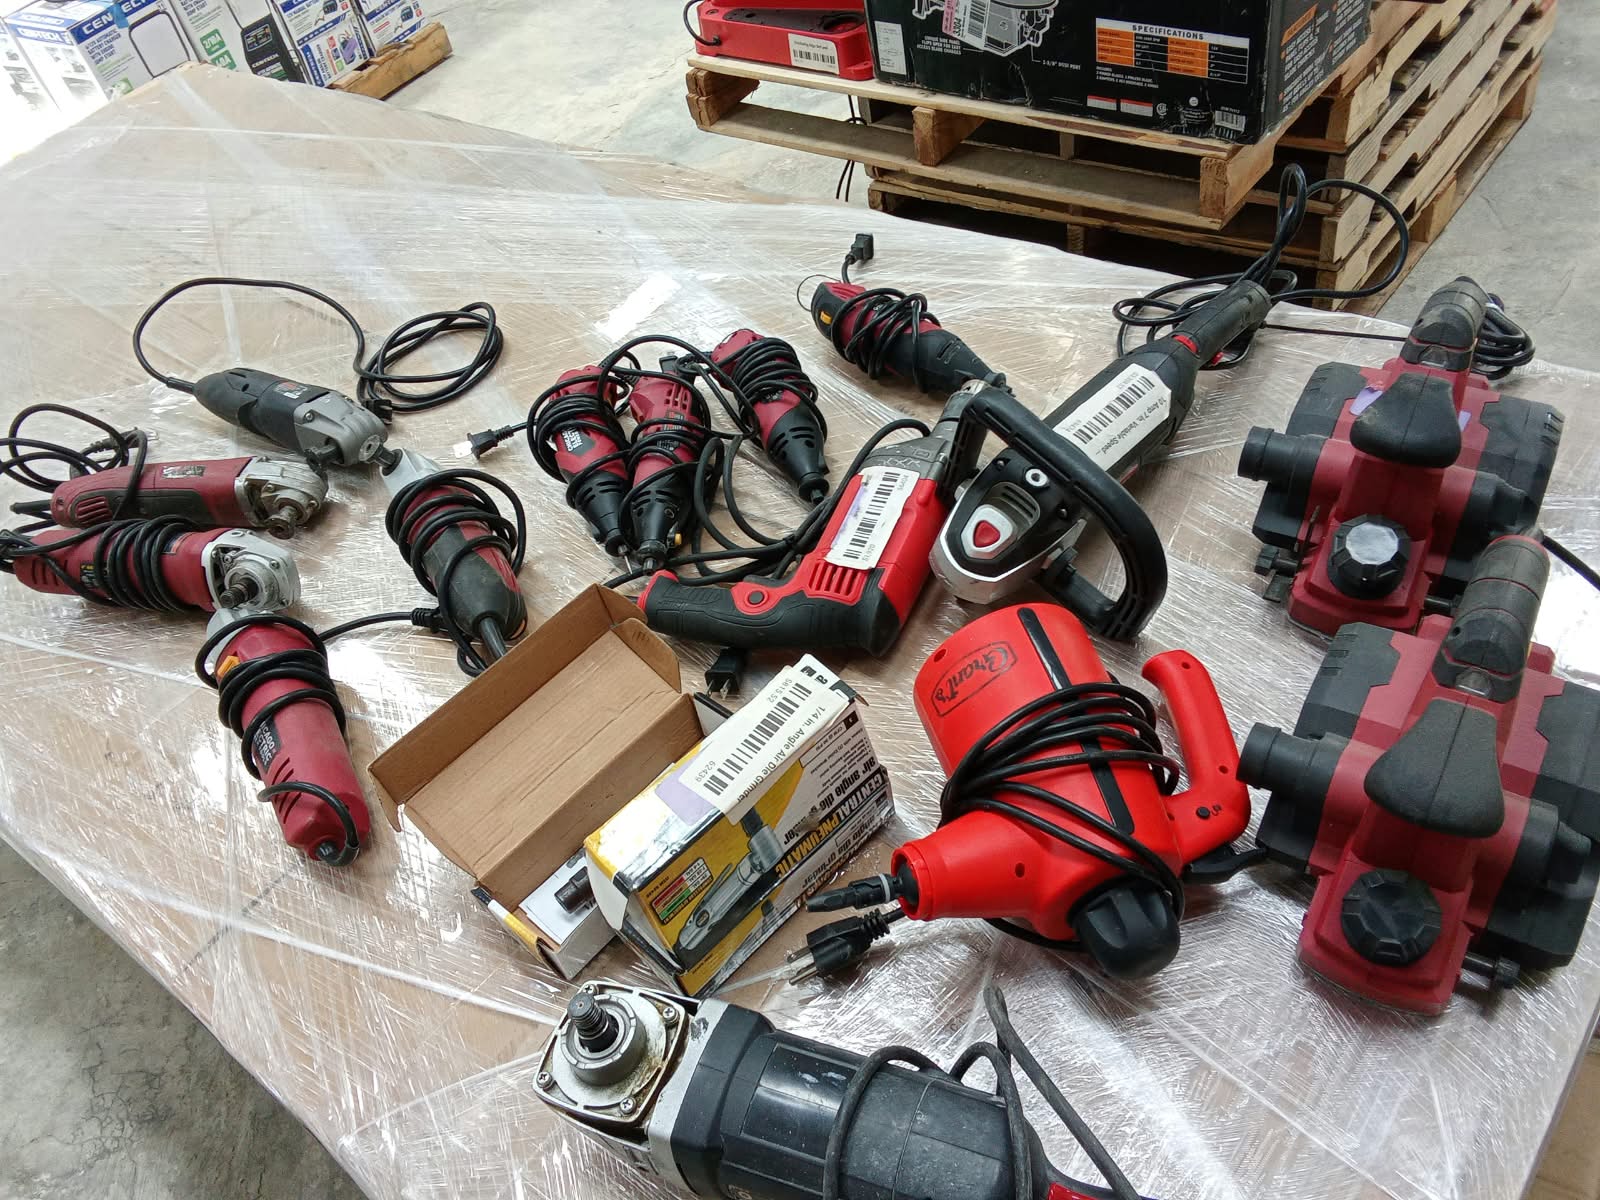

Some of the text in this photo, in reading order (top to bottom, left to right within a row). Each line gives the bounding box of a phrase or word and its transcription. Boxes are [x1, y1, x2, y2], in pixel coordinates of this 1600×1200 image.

[1132, 24, 1204, 40] SPECIFICATIONS
[809, 702, 826, 720] 1/4
[801, 716, 815, 730] in.
[781, 725, 805, 752] Angle
[771, 748, 786, 764] Air
[858, 755, 877, 774] air
[760, 760, 776, 777] Die
[735, 772, 765, 806] Grinder
[831, 768, 862, 798] angle
[818, 792, 836, 810] die
